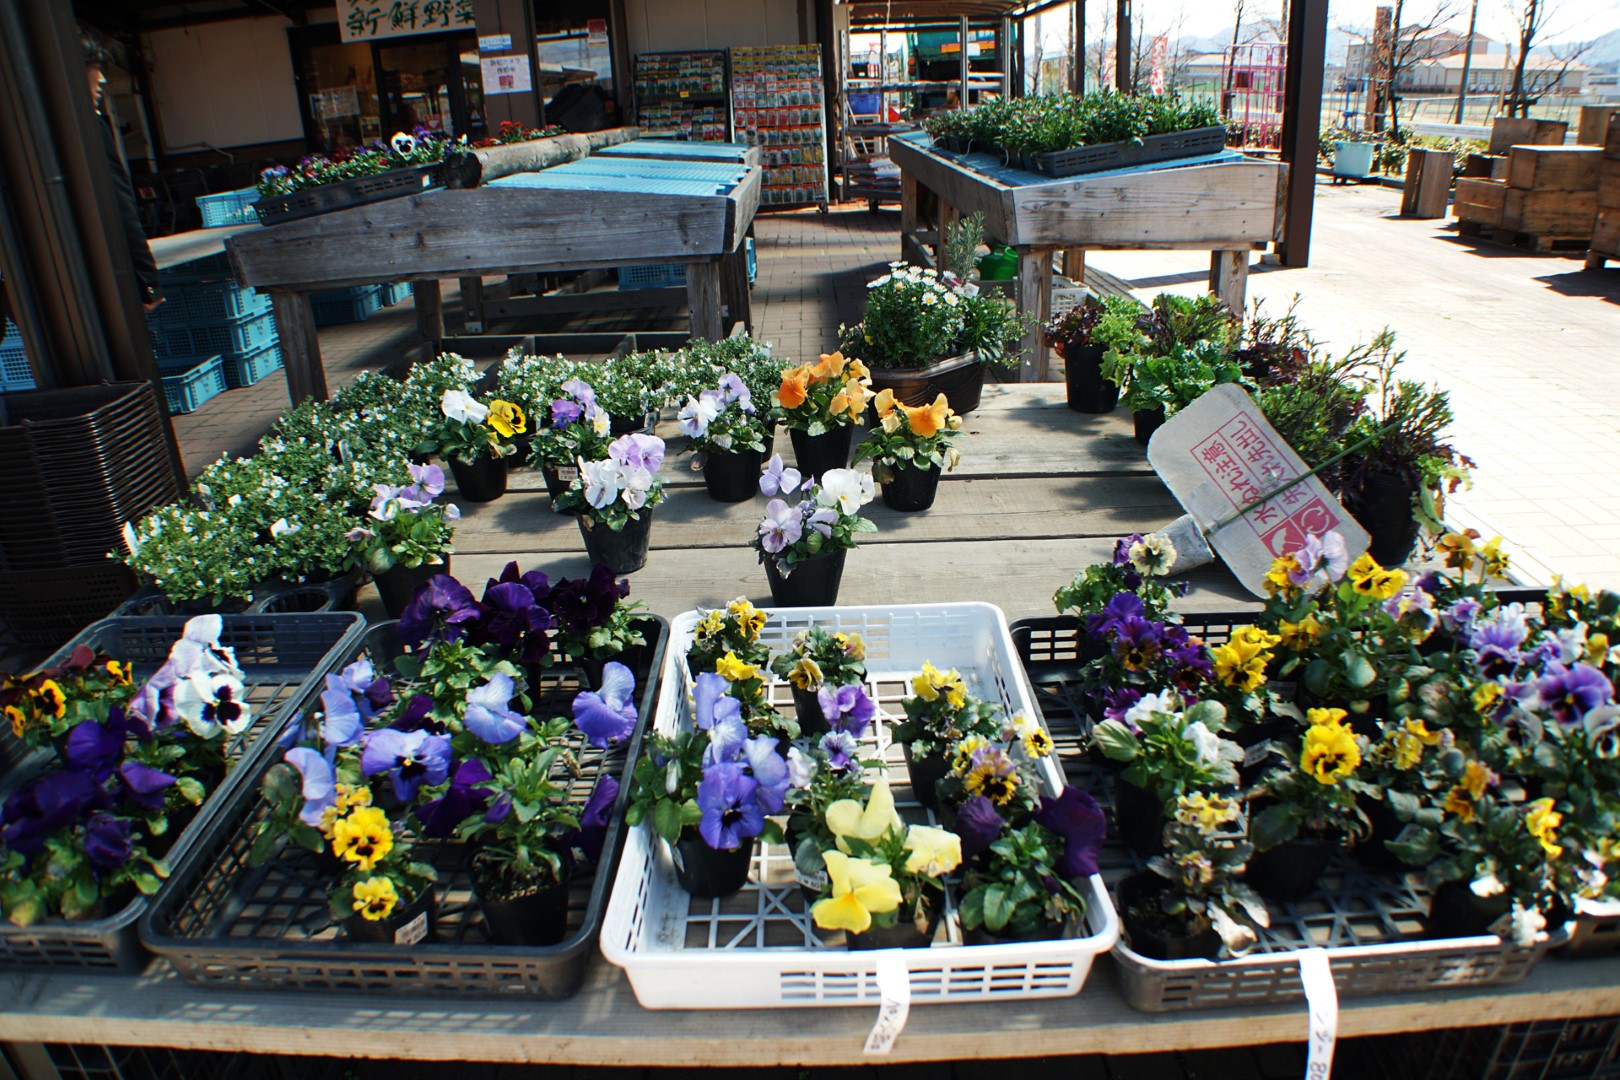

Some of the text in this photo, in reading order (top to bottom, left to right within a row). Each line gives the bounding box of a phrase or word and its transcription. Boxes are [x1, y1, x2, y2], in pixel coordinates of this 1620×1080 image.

[346, 0, 476, 36] 新鮮野菜
[1201, 439, 1278, 525] 水ぬれ注意
